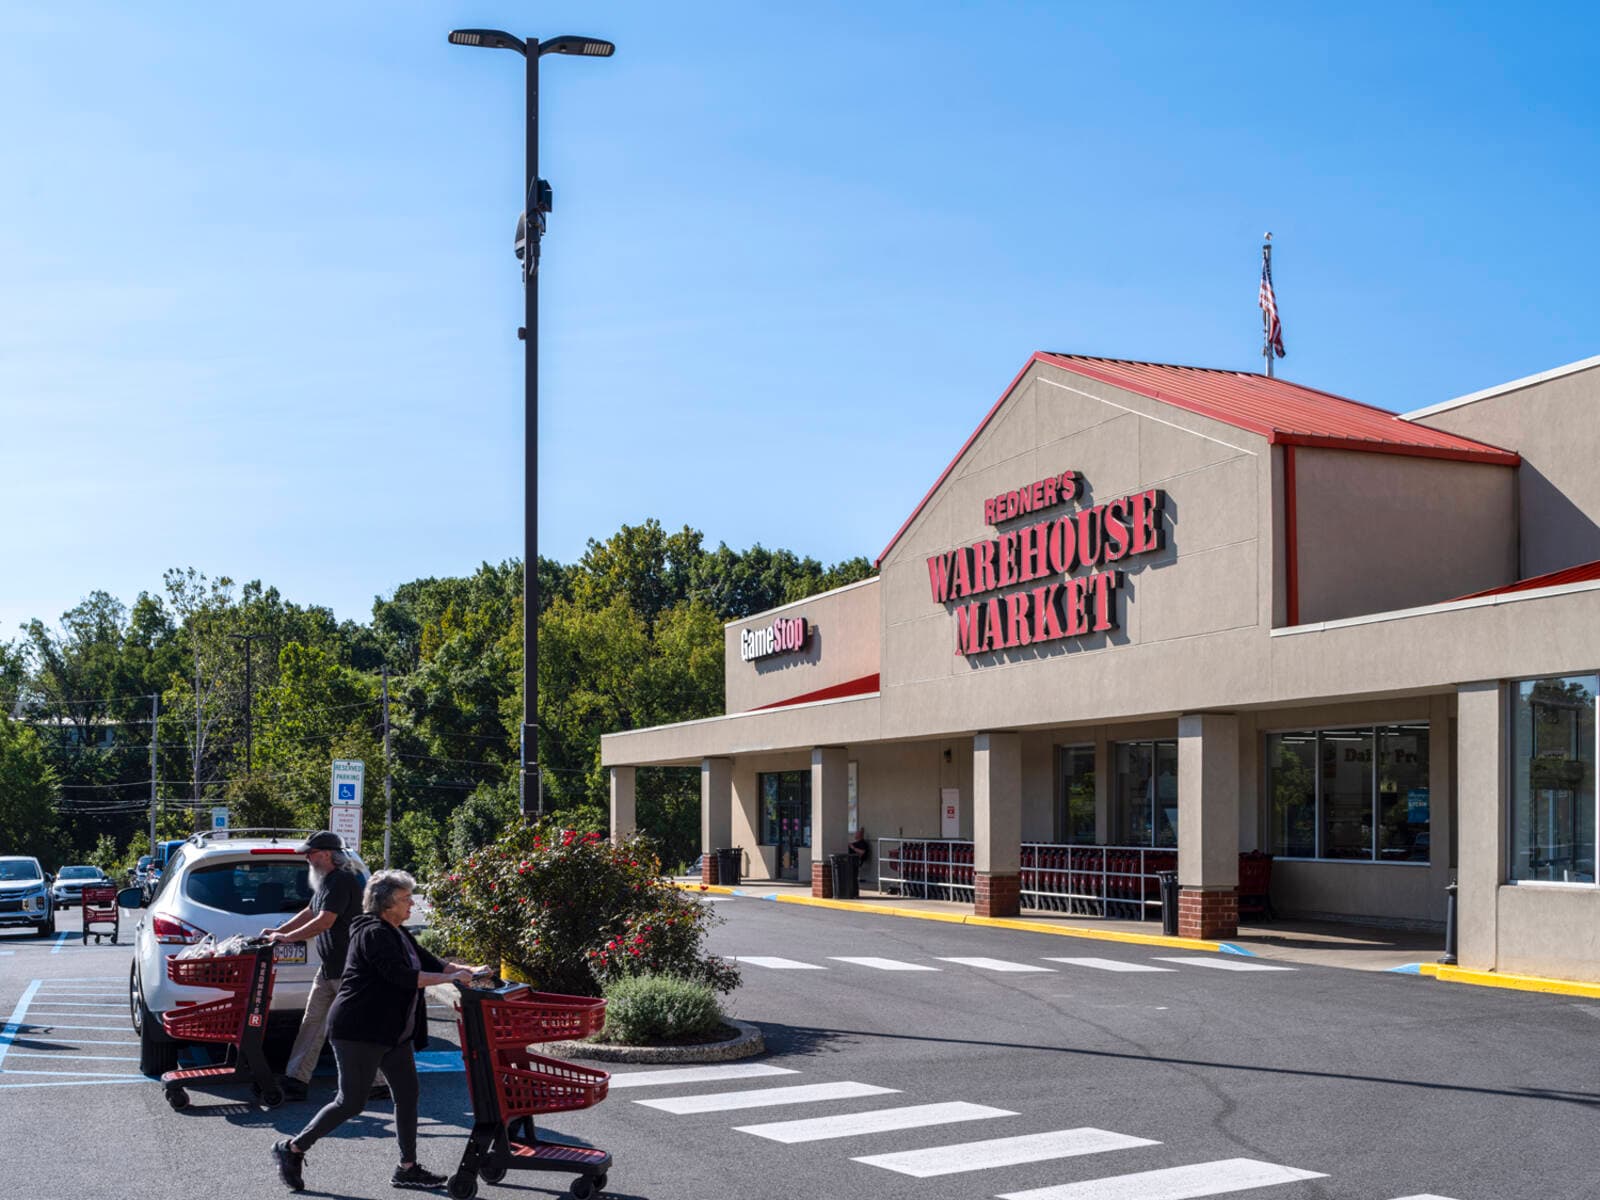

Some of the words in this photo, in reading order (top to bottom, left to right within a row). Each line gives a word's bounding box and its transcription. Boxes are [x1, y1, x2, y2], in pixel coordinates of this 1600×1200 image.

[984, 470, 1077, 526] REDNER'S
[927, 489, 1160, 604] WAREHOUSE
[955, 570, 1118, 656] MARKET
[741, 617, 803, 661] GameStop
[335, 764, 363, 772] RESERVED
[336, 773, 360, 781] PARKING
[1344, 748, 1390, 765] Daiy
